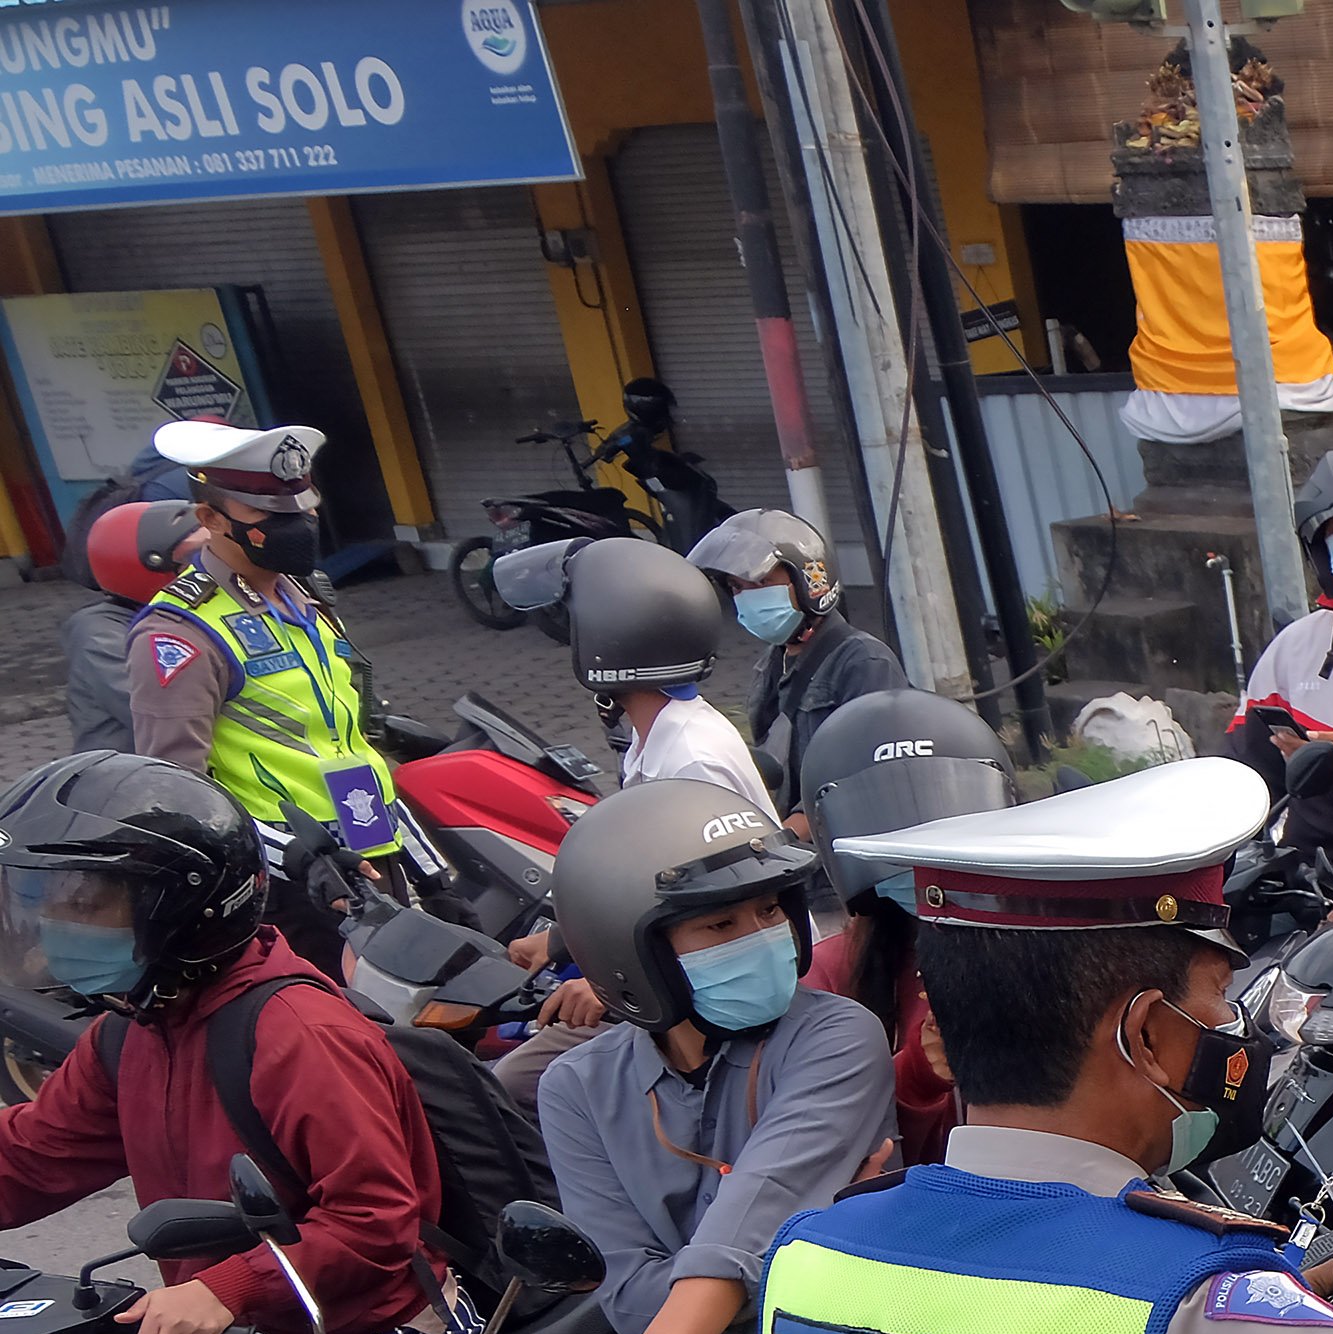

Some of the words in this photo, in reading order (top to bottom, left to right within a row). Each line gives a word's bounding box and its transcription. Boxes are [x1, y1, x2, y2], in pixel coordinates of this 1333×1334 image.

[469, 8, 515, 34] AQUA
[121, 71, 241, 142] ASLI
[245, 56, 405, 134] SOLO
[32, 160, 117, 186] MENERIMA
[116, 154, 193, 180] PESANAN
[201, 151, 235, 174] 081
[234, 149, 267, 172] 337
[268, 147, 301, 169] 711
[303, 144, 338, 168] 222
[588, 669, 636, 682] HBC
[874, 740, 934, 762] ARC
[703, 811, 763, 844] ARC
[1223, 1087, 1237, 1101] TNI
[1252, 1155, 1282, 1192] ABC
[1215, 1276, 1237, 1308] POLISI
